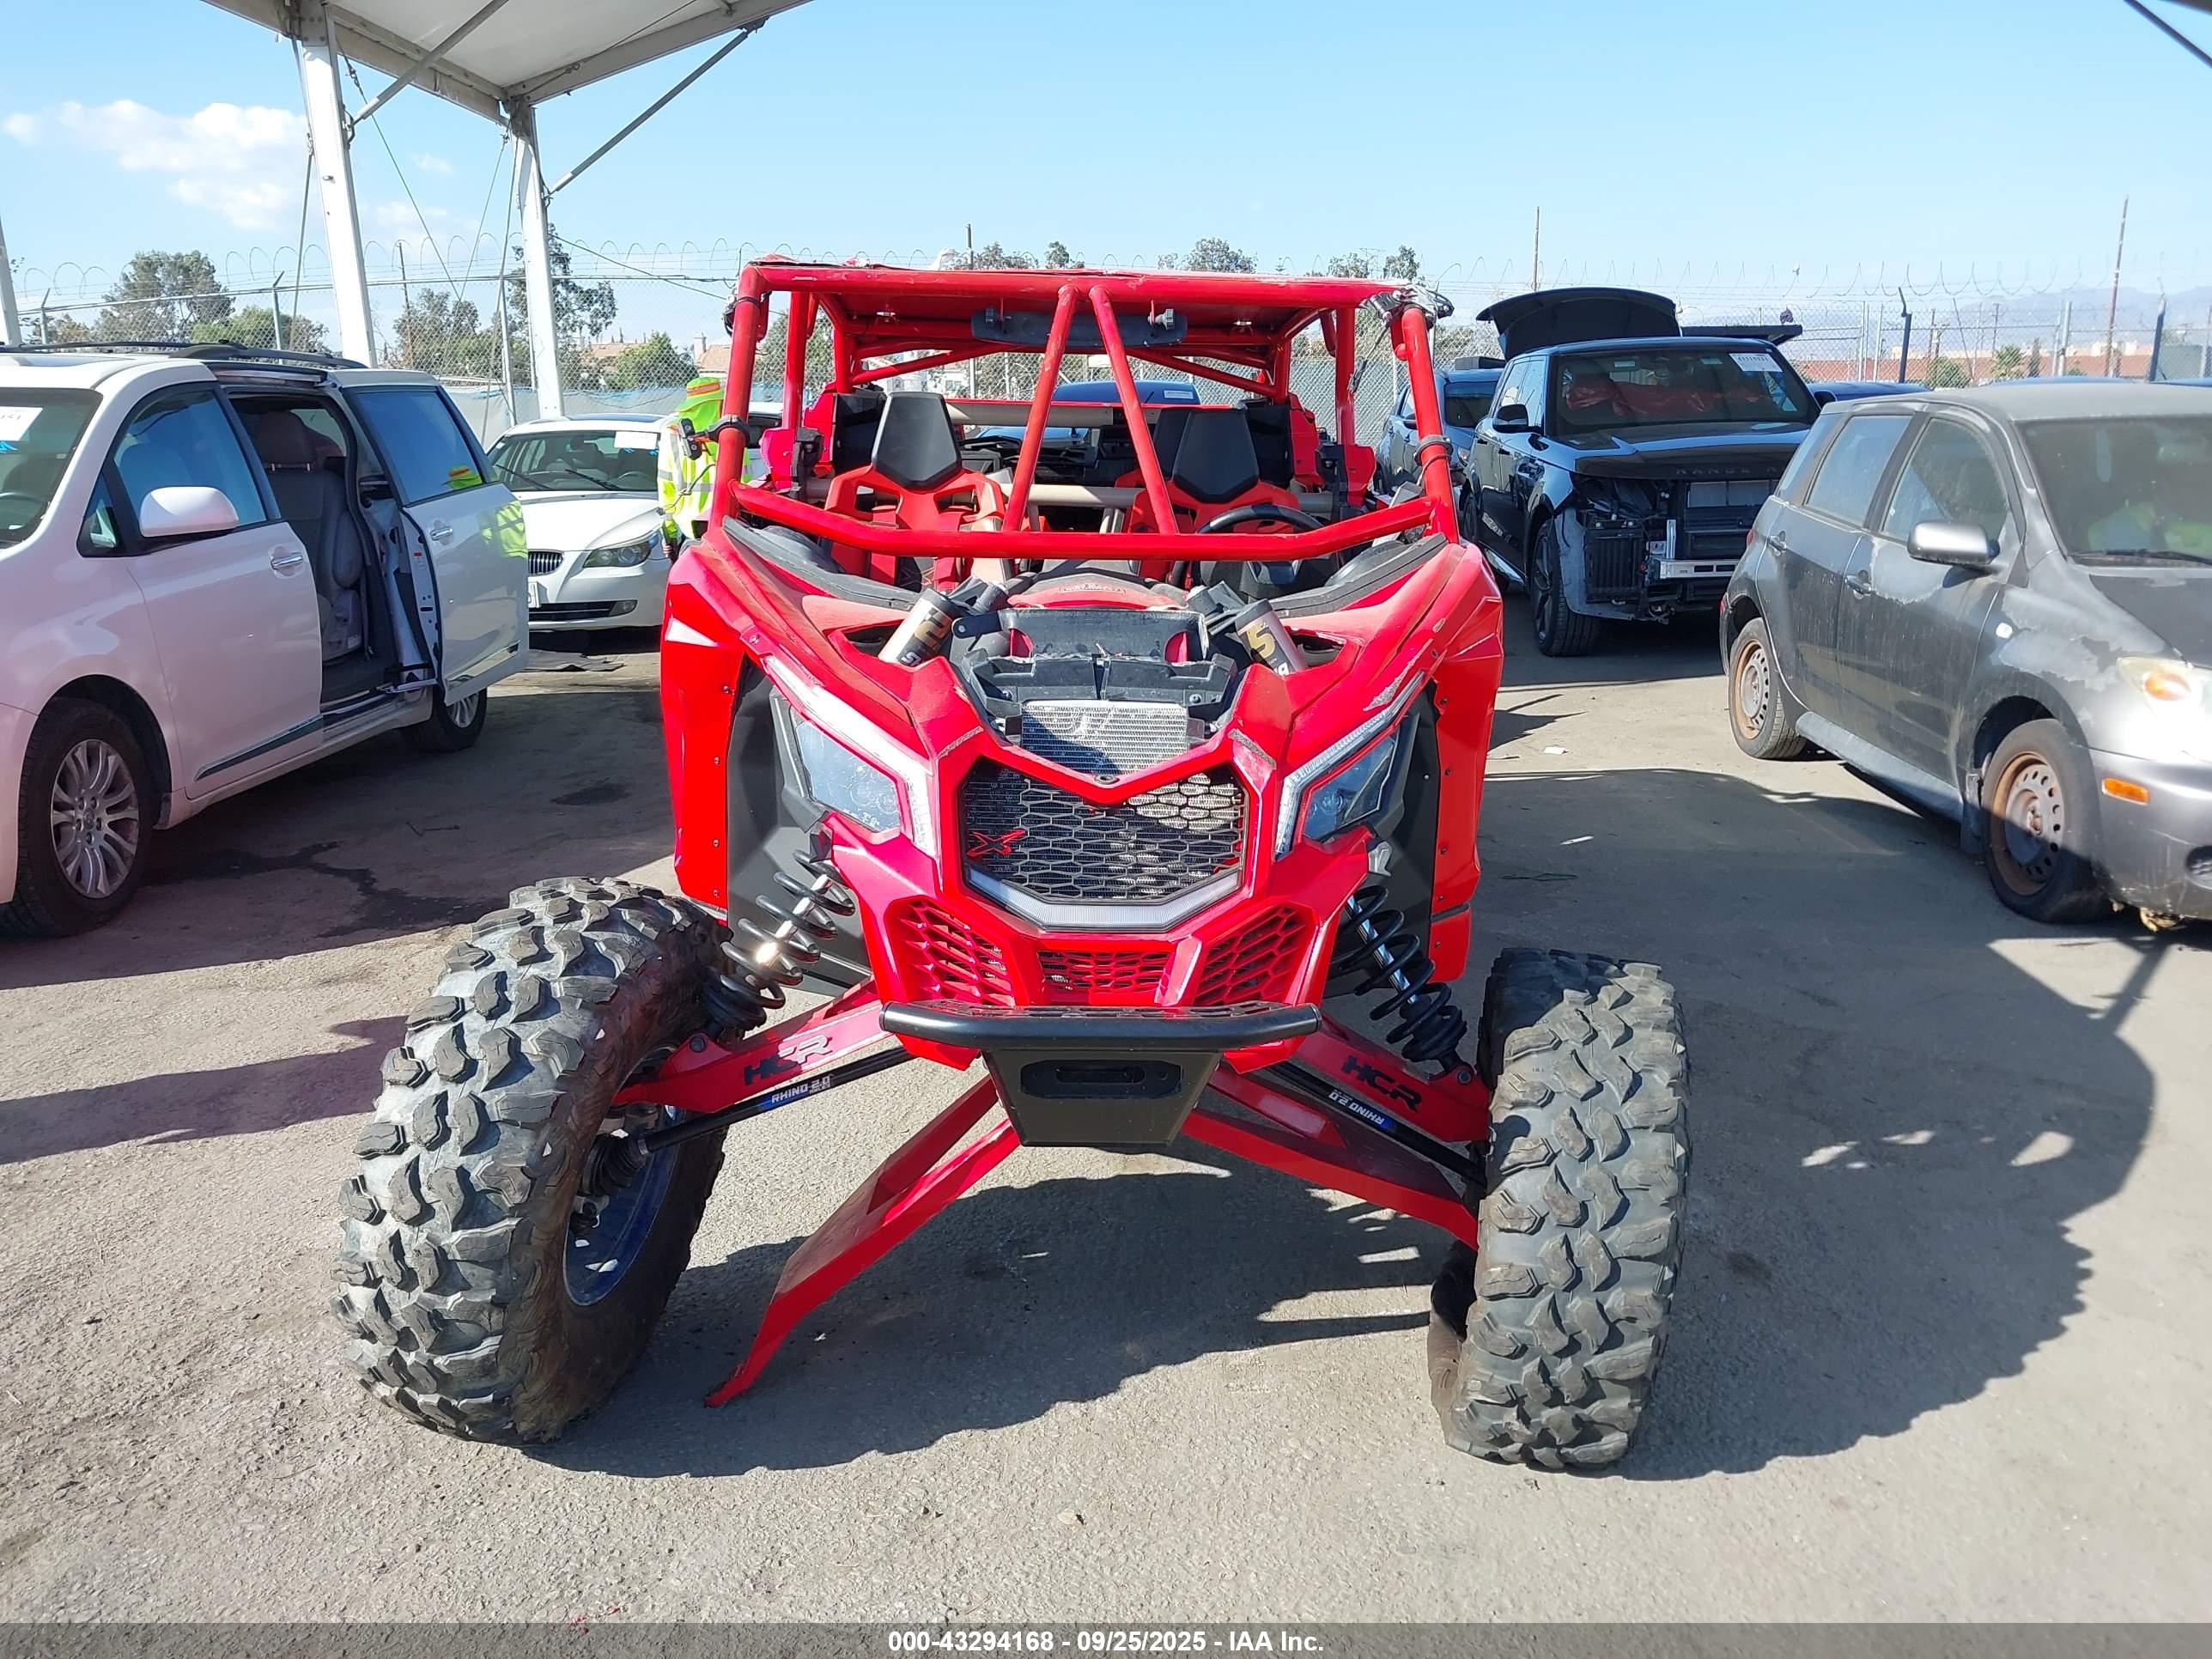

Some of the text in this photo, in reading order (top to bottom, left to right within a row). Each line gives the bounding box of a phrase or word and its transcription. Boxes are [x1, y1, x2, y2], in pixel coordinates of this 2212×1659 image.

[744, 1034, 833, 1086] HCR
[770, 1074, 831, 1104] RHINO 2.0
[1328, 1091, 1350, 1107] 2.0
[1341, 1054, 1423, 1114] HCR
[1348, 1102, 1386, 1126] RHINO
